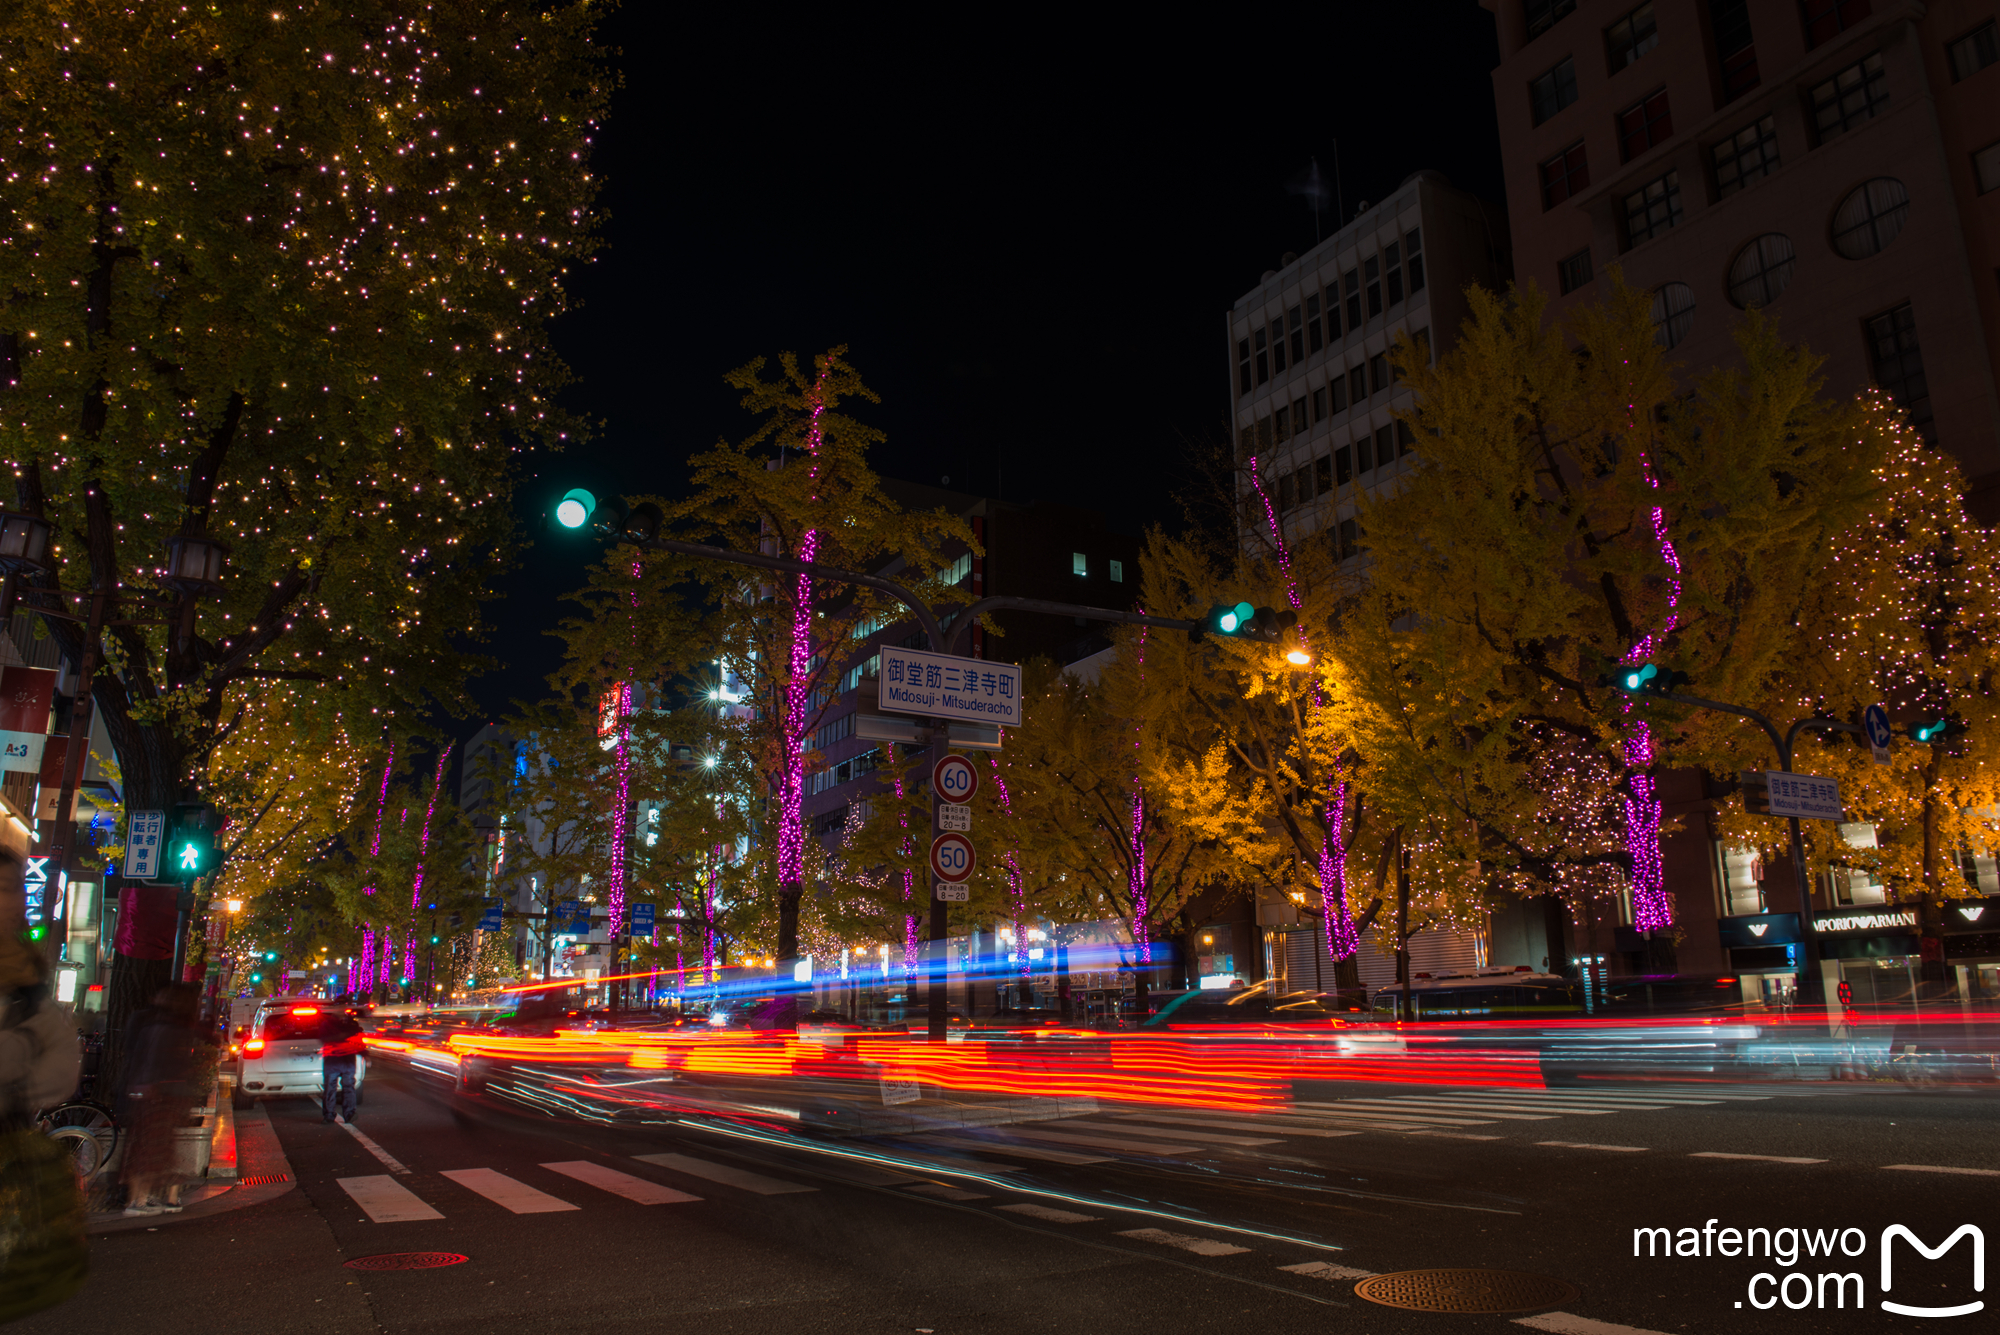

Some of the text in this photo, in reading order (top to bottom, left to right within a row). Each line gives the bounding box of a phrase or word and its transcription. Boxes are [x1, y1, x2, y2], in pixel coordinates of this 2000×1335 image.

[888, 657, 1014, 699] 御堂筋三津寺町
[888, 687, 1013, 716] Midosuji-Mitsuderacho
[944, 768, 968, 791] 60
[1771, 778, 1837, 803] 御堂筋三津寺町
[1773, 797, 1838, 814] Midosuji-Mitsuderacho
[135, 848, 149, 874] 専用
[941, 847, 965, 869] 50
[1813, 912, 1917, 932] MPORIO ARMANI
